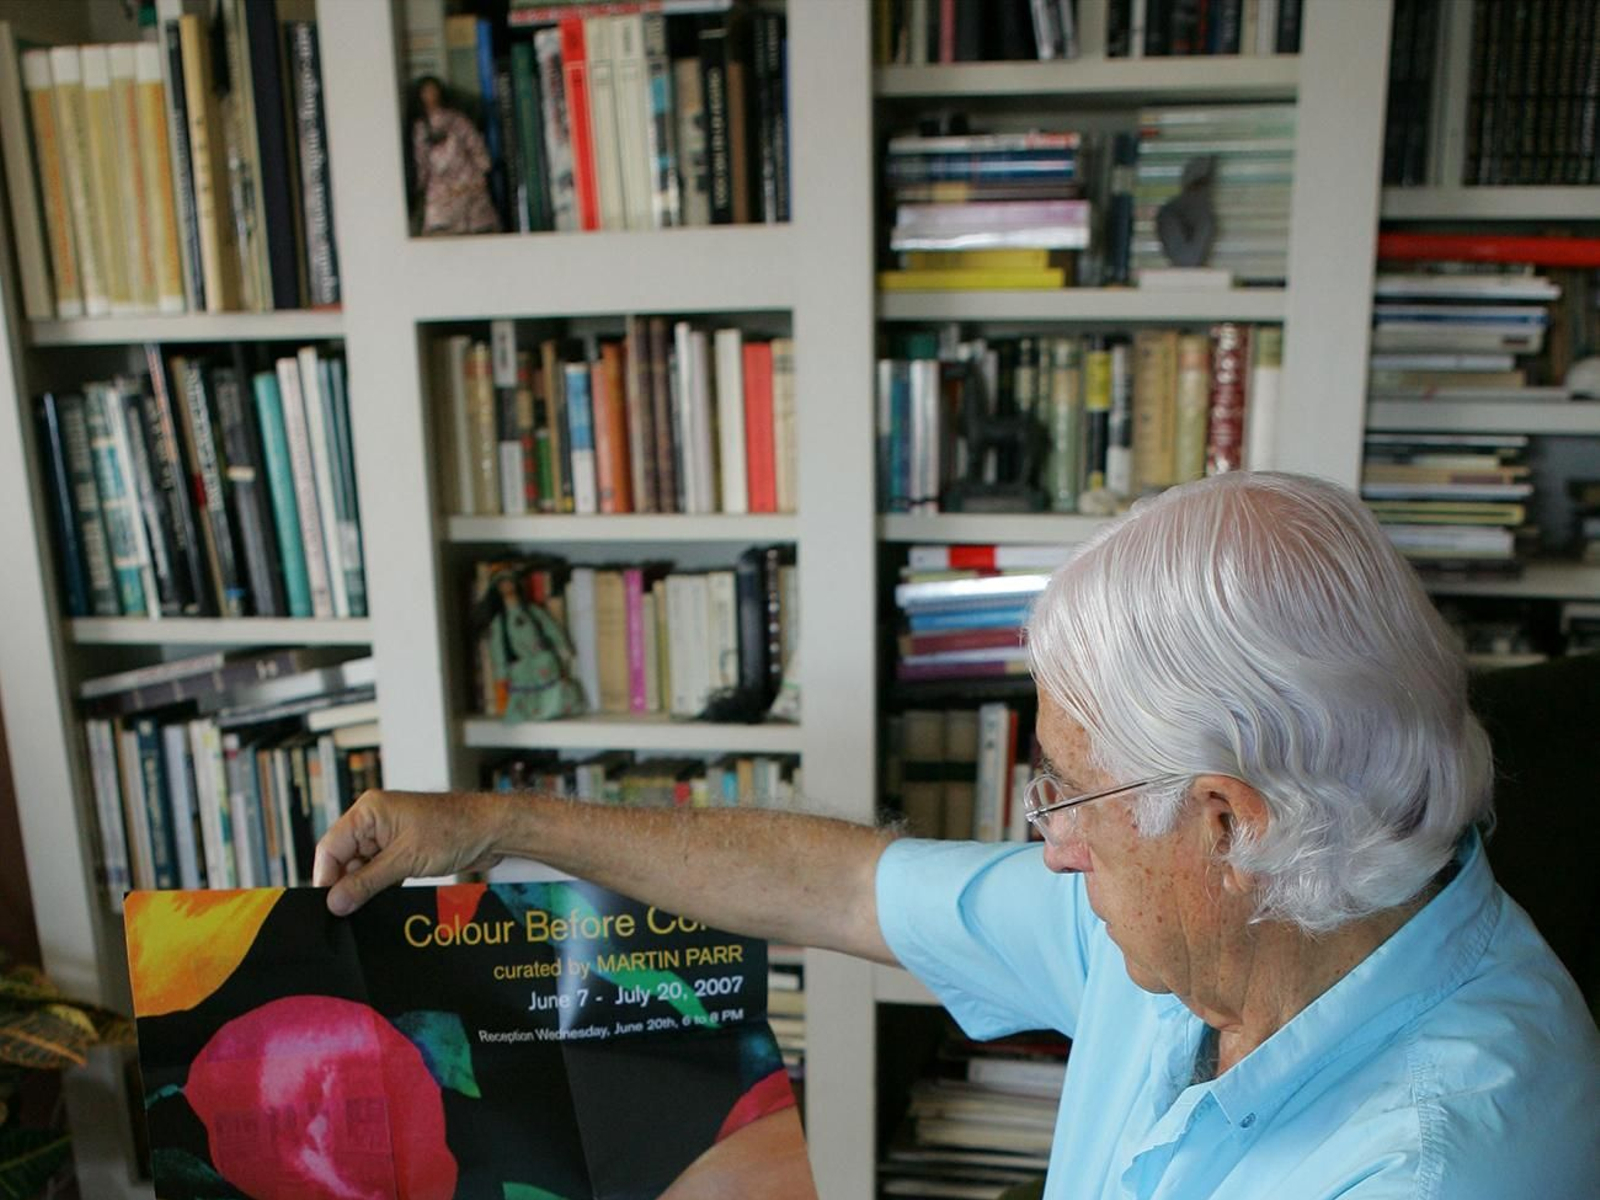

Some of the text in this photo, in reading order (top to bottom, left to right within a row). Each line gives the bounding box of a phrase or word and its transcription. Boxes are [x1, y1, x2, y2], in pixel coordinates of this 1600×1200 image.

[404, 906, 707, 948] Colour Before Co
[493, 944, 744, 980] curated by MARTIN PARR
[528, 990, 571, 1011] June
[577, 988, 589, 1007] 7
[615, 984, 651, 1008] July
[657, 981, 689, 1001] 20,
[694, 975, 744, 998] 2007
[478, 1029, 534, 1044] Reception
[534, 1023, 611, 1041] Wednesday,
[614, 1021, 644, 1035] June
[646, 1016, 679, 1031] 20th,
[682, 1014, 691, 1027] 6
[694, 1013, 708, 1025] to
[721, 1007, 744, 1022] PM
